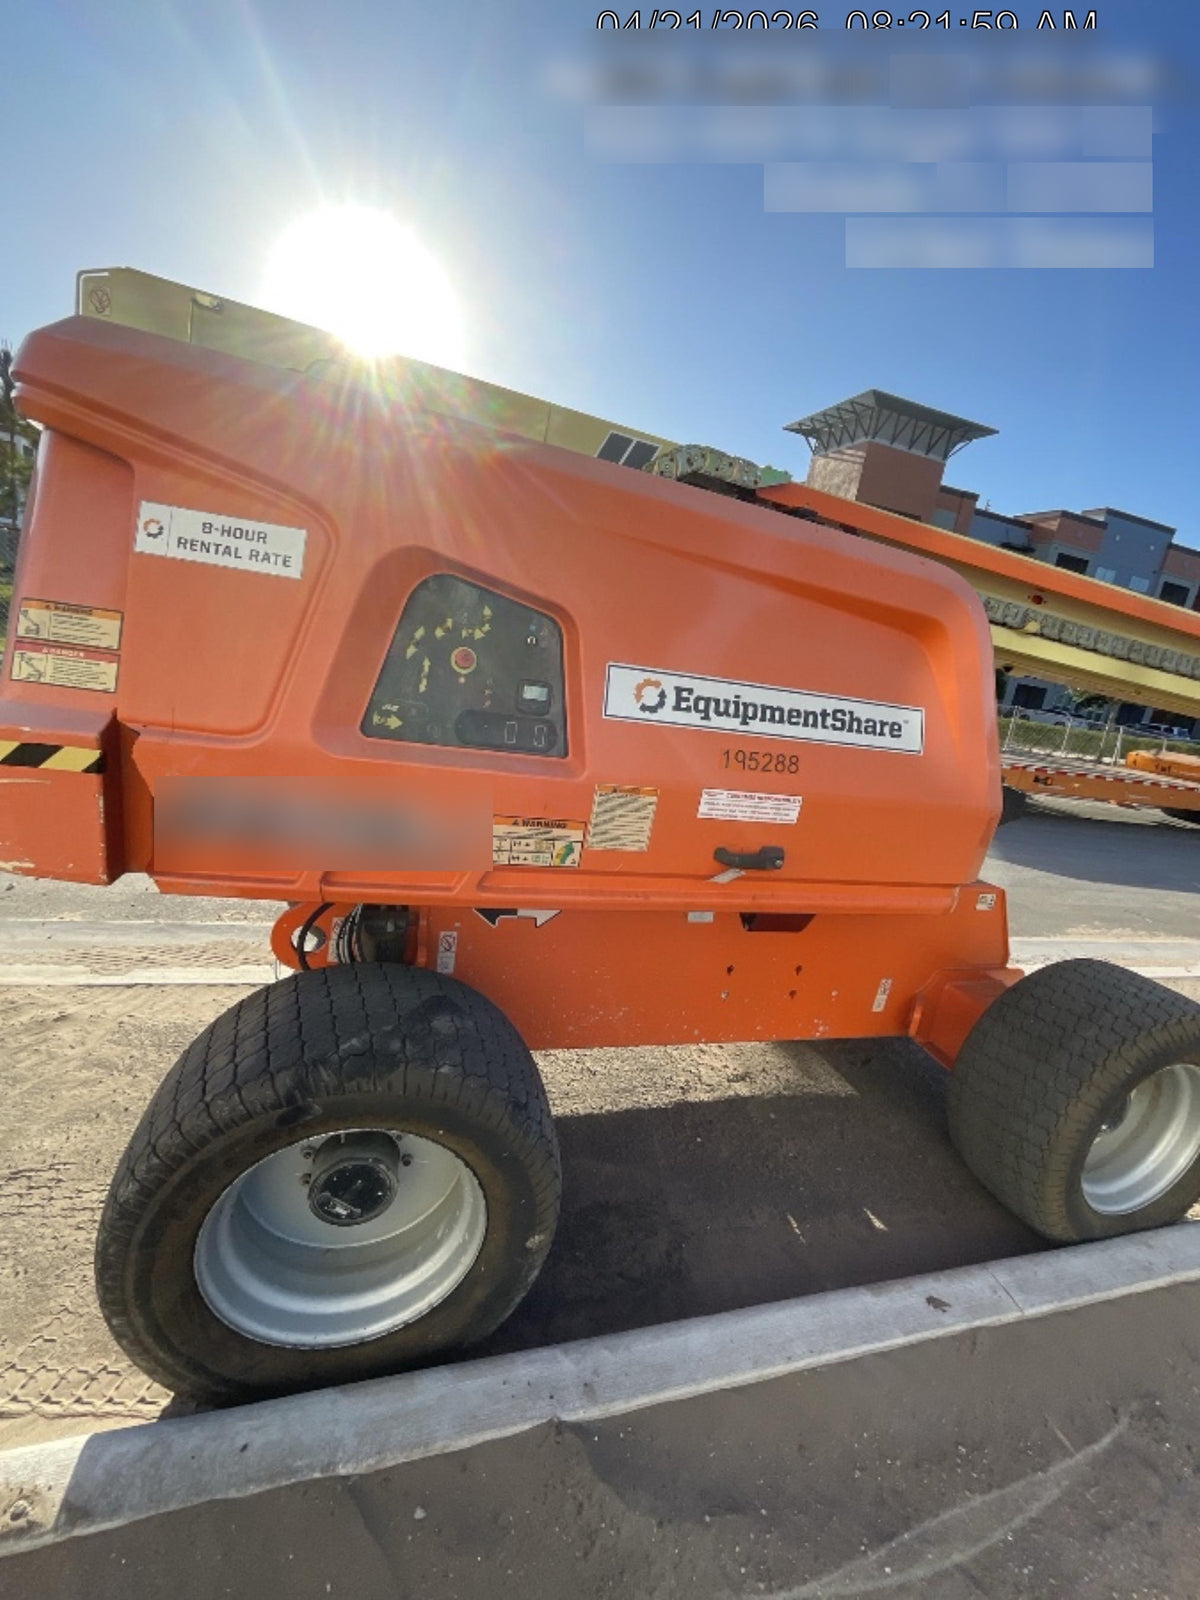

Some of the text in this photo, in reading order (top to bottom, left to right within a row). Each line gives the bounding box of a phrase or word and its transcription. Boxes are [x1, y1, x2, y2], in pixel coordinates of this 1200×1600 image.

[202, 522, 268, 544] 8-HOUR
[177, 536, 292, 568] RENTAL RATE
[672, 685, 904, 738] EquipmentShare
[722, 749, 800, 774] 195288
